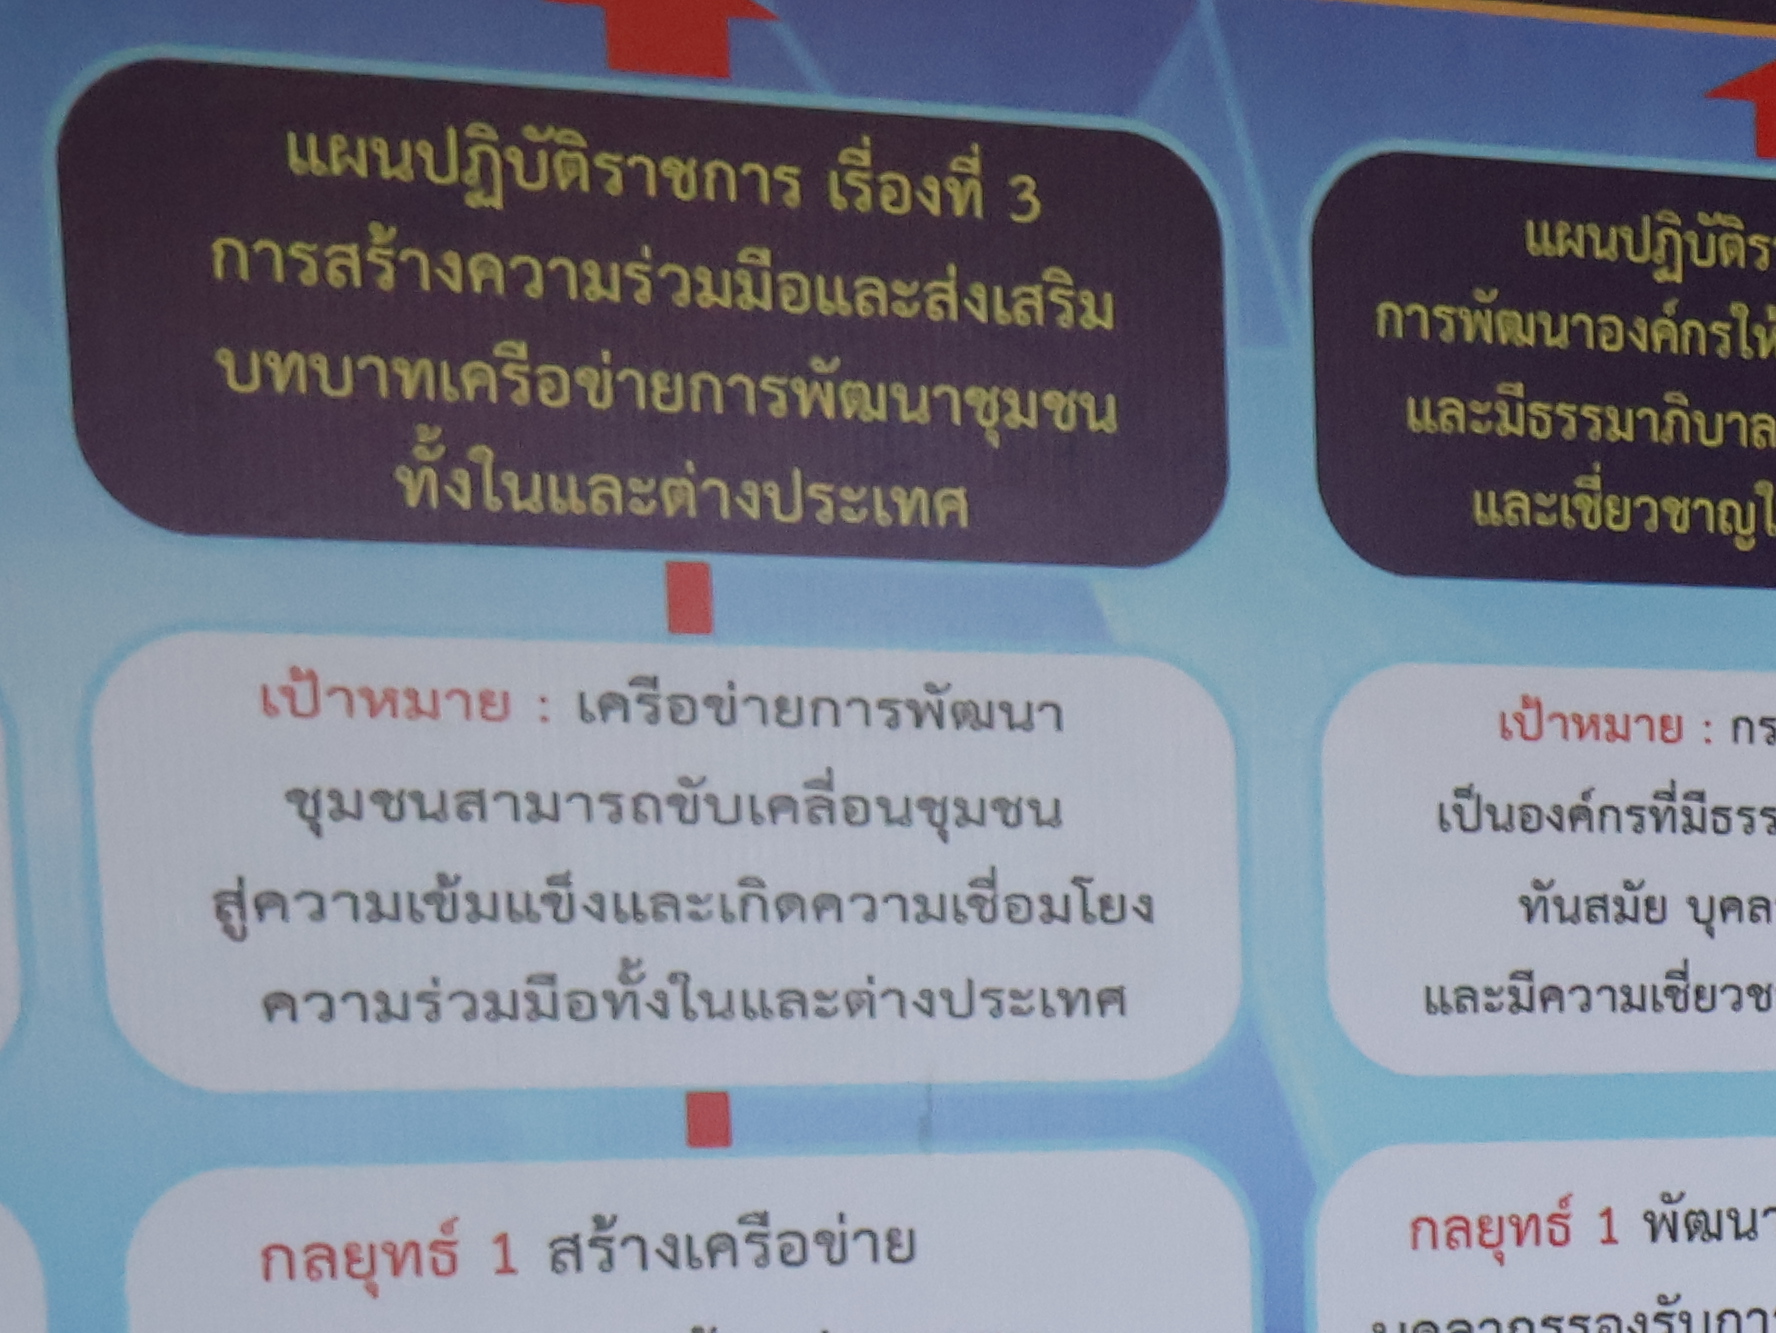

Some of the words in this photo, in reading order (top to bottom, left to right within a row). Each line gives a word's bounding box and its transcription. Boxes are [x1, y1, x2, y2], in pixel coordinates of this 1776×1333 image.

[287, 129, 801, 209] แผนปฏิบัติราชการ
[829, 136, 983, 219] เรื่องที่
[1009, 174, 1041, 223] 3
[211, 224, 1114, 330] การสร้างความร่วมมือและส่งเสริม
[215, 344, 1118, 449] บทบาทเครือข่ายการพัฒนาชุมชน
[1407, 382, 1776, 449] และมีธรรมาภิบาล
[394, 424, 968, 528] ทั้งในและต่างประเทศ
[260, 665, 511, 723] เป้าหมาย
[578, 675, 1063, 733] เครือข่ายการพัฒนา
[1500, 694, 1683, 745] เป้าหมาย
[284, 766, 1063, 844] ชุมชนสามารถขับเคลื่อนชุมชน
[212, 865, 1154, 943] สู่ความเข้มแข็งและเกิดความเชื่อมโยง
[1519, 878, 1667, 925] ทันสมัย
[261, 956, 1126, 1024] ความร่วมมือทั้งในและต่างประเทศ
[261, 1216, 459, 1299] กลยุทธ์
[493, 1232, 518, 1275] 1
[548, 1210, 916, 1275] สร้างเครือข่าย
[1410, 1193, 1573, 1267] กลยุทธ์
[1599, 1207, 1618, 1245] 1
